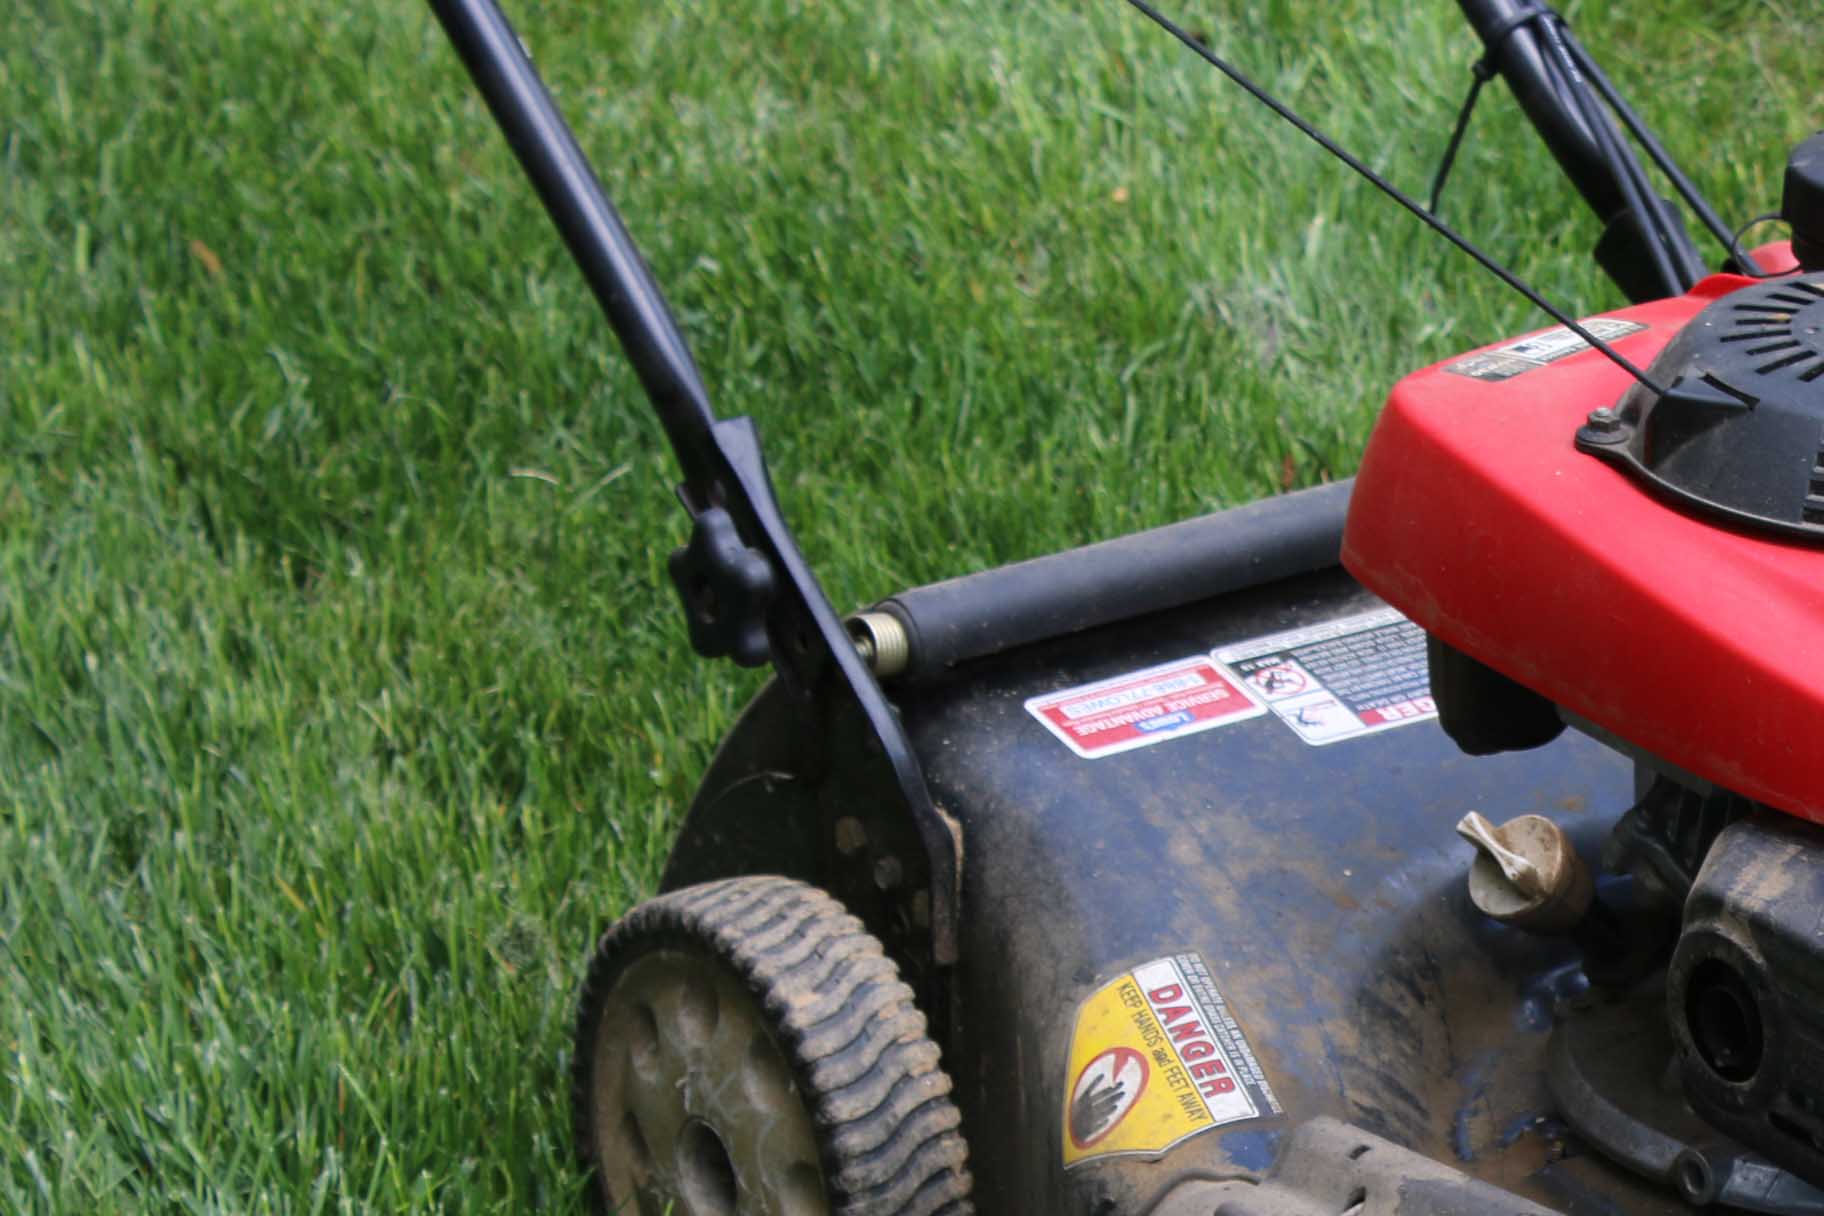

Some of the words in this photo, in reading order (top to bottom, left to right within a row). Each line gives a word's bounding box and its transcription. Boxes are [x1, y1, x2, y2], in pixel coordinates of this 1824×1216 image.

[1164, 688, 1230, 712] SERVICE
[1073, 705, 1165, 736] ADVANTAGE
[1118, 982, 1143, 1011] KEEP
[1132, 1009, 1164, 1048] HANDS
[1147, 983, 1236, 1099] DANGER
[1151, 1047, 1173, 1068] and
[1166, 1064, 1191, 1093] FEET
[1176, 1090, 1209, 1122] AWAY
